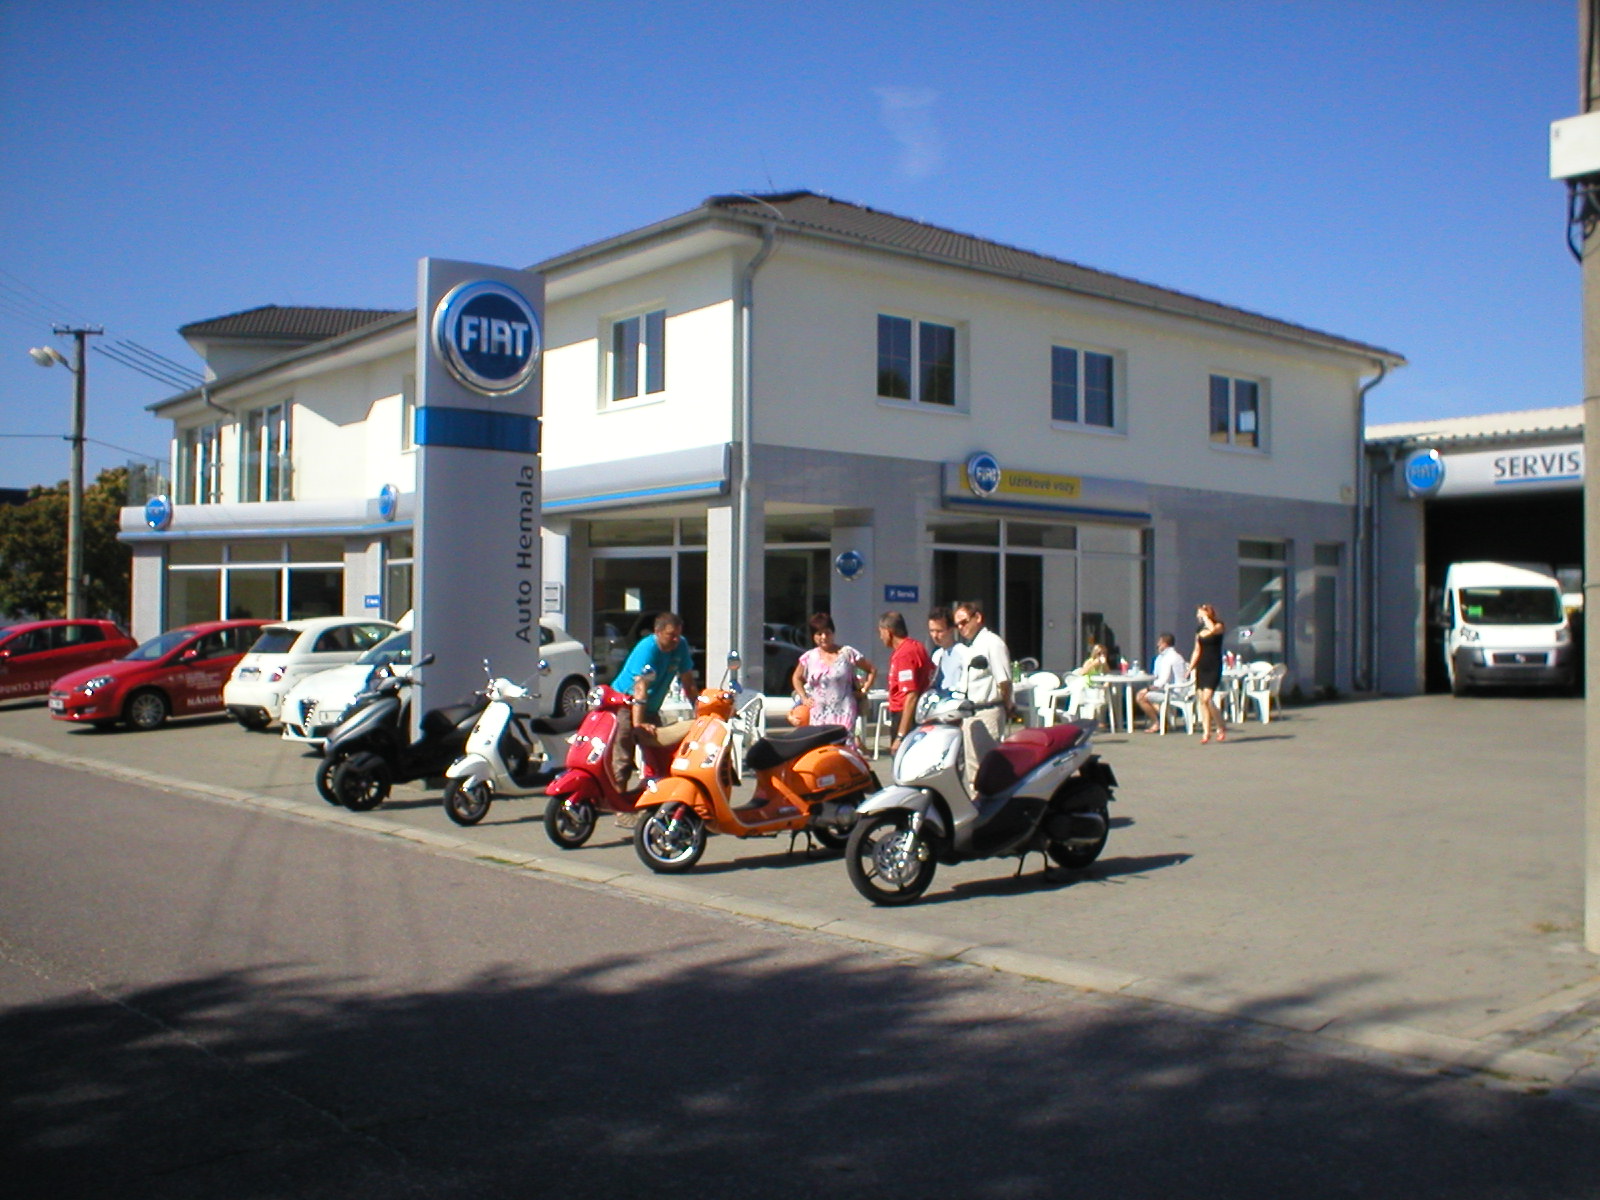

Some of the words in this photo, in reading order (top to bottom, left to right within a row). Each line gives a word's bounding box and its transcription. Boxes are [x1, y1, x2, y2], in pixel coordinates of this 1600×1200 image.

[461, 314, 529, 357] FIAT
[1408, 463, 1440, 480] FIAT
[1494, 451, 1580, 478] SERVIS
[515, 465, 534, 570] Hemala
[515, 580, 532, 644] Auto
